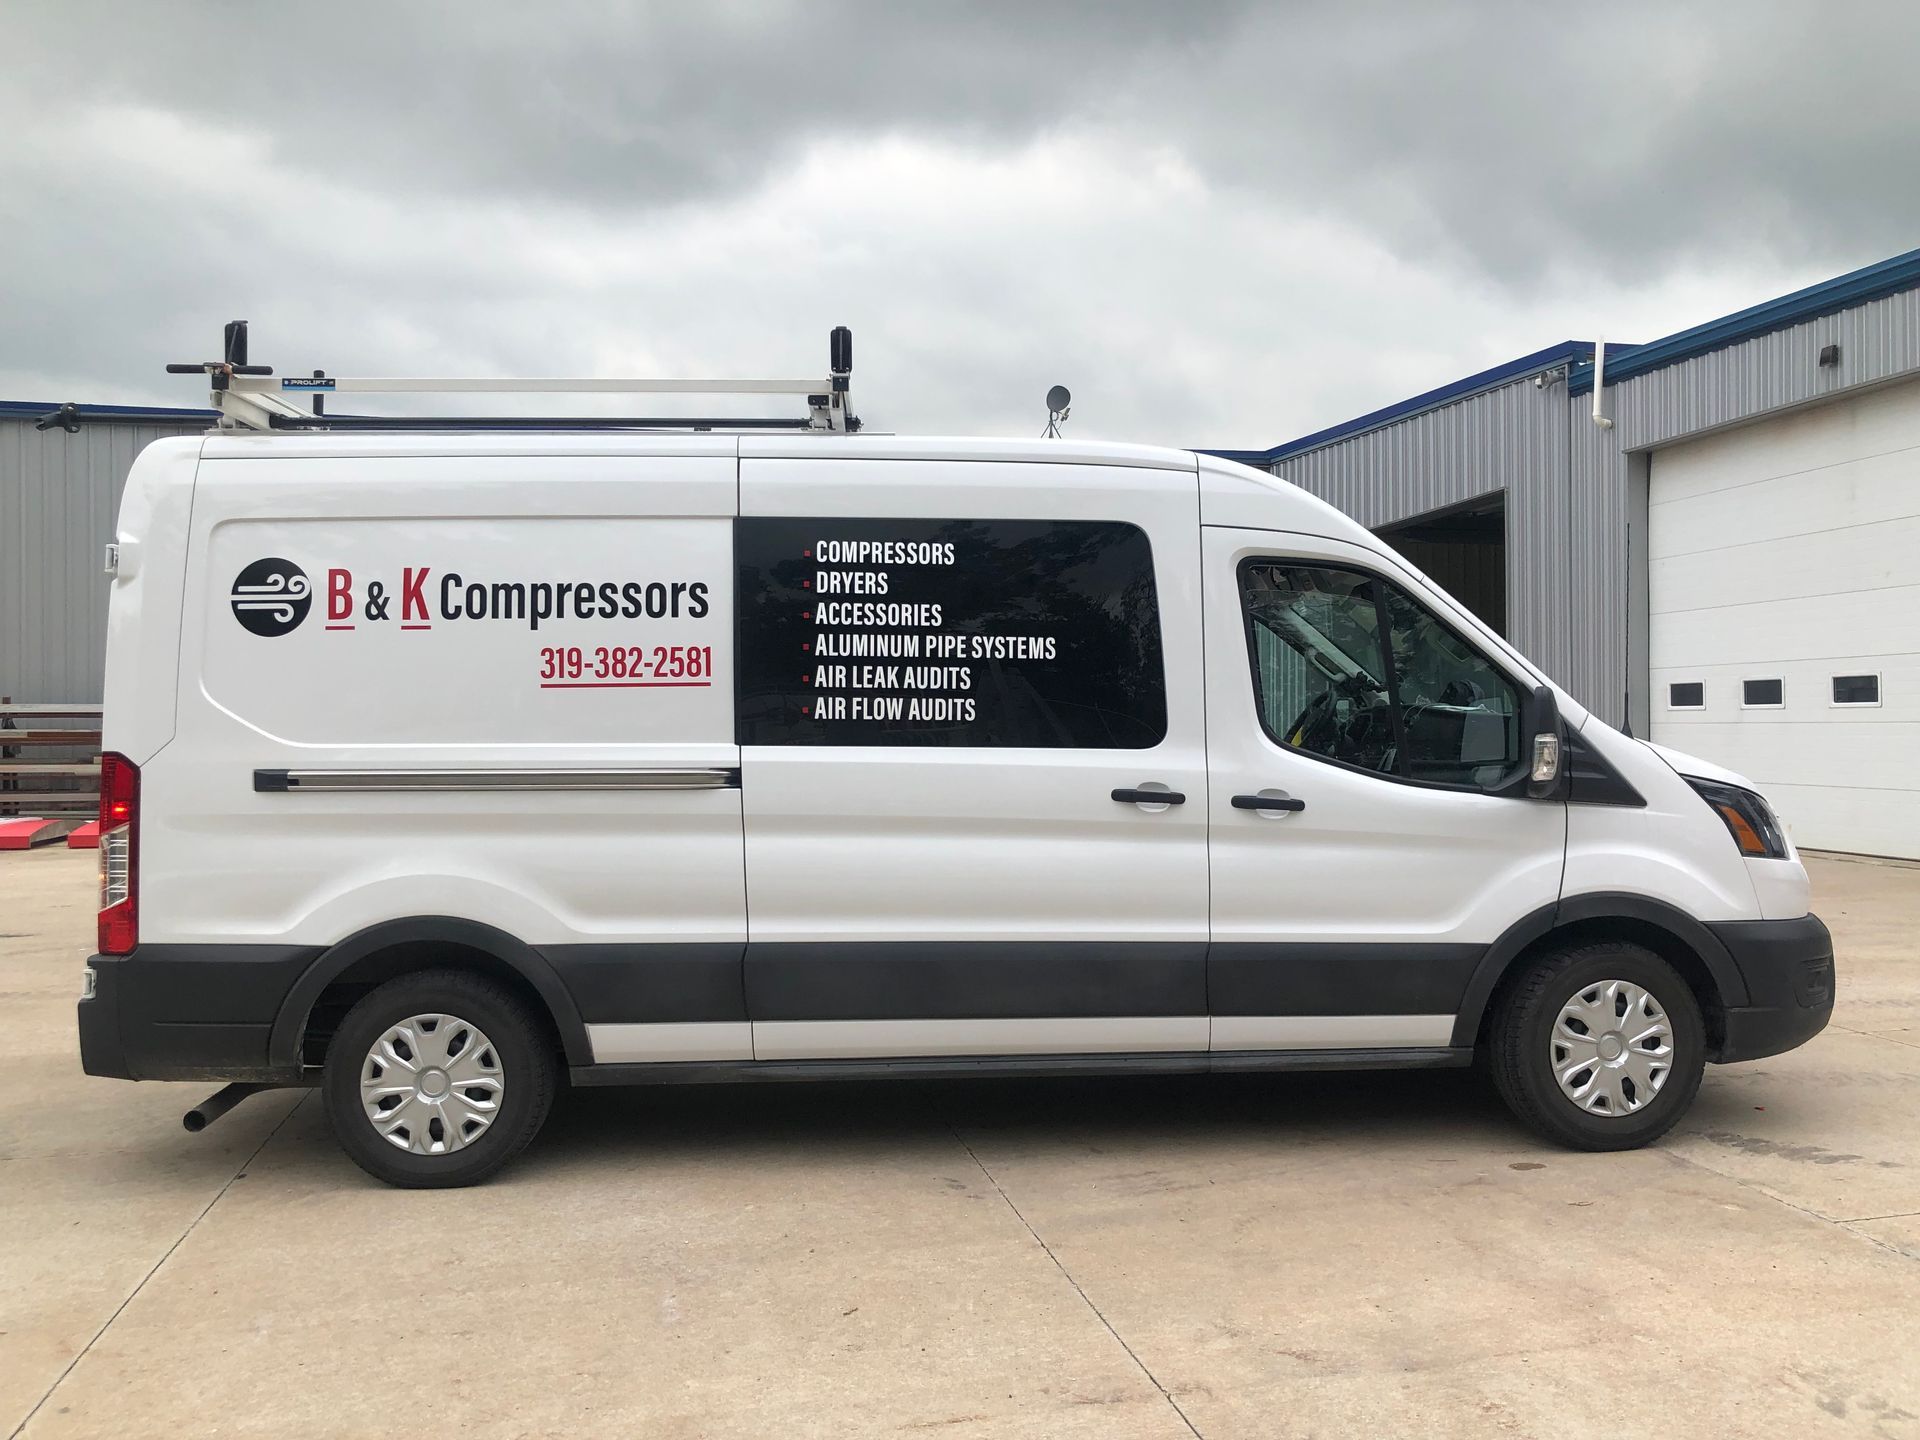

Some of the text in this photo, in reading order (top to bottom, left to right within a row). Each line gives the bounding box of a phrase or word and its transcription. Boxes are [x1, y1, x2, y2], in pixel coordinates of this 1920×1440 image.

[816, 540, 955, 565] COMPRESSORS
[816, 571, 888, 595] DRYERS
[326, 567, 710, 631] B & K Compressors
[815, 602, 942, 626] ACCESSORIES
[815, 633, 1056, 660] ALUMINUM PIPE SYSTEMS
[540, 646, 711, 679] 319-382-2581
[814, 665, 971, 690] AIR LEAK AUDITS
[814, 697, 976, 721] AIR FLOW AUDITS
